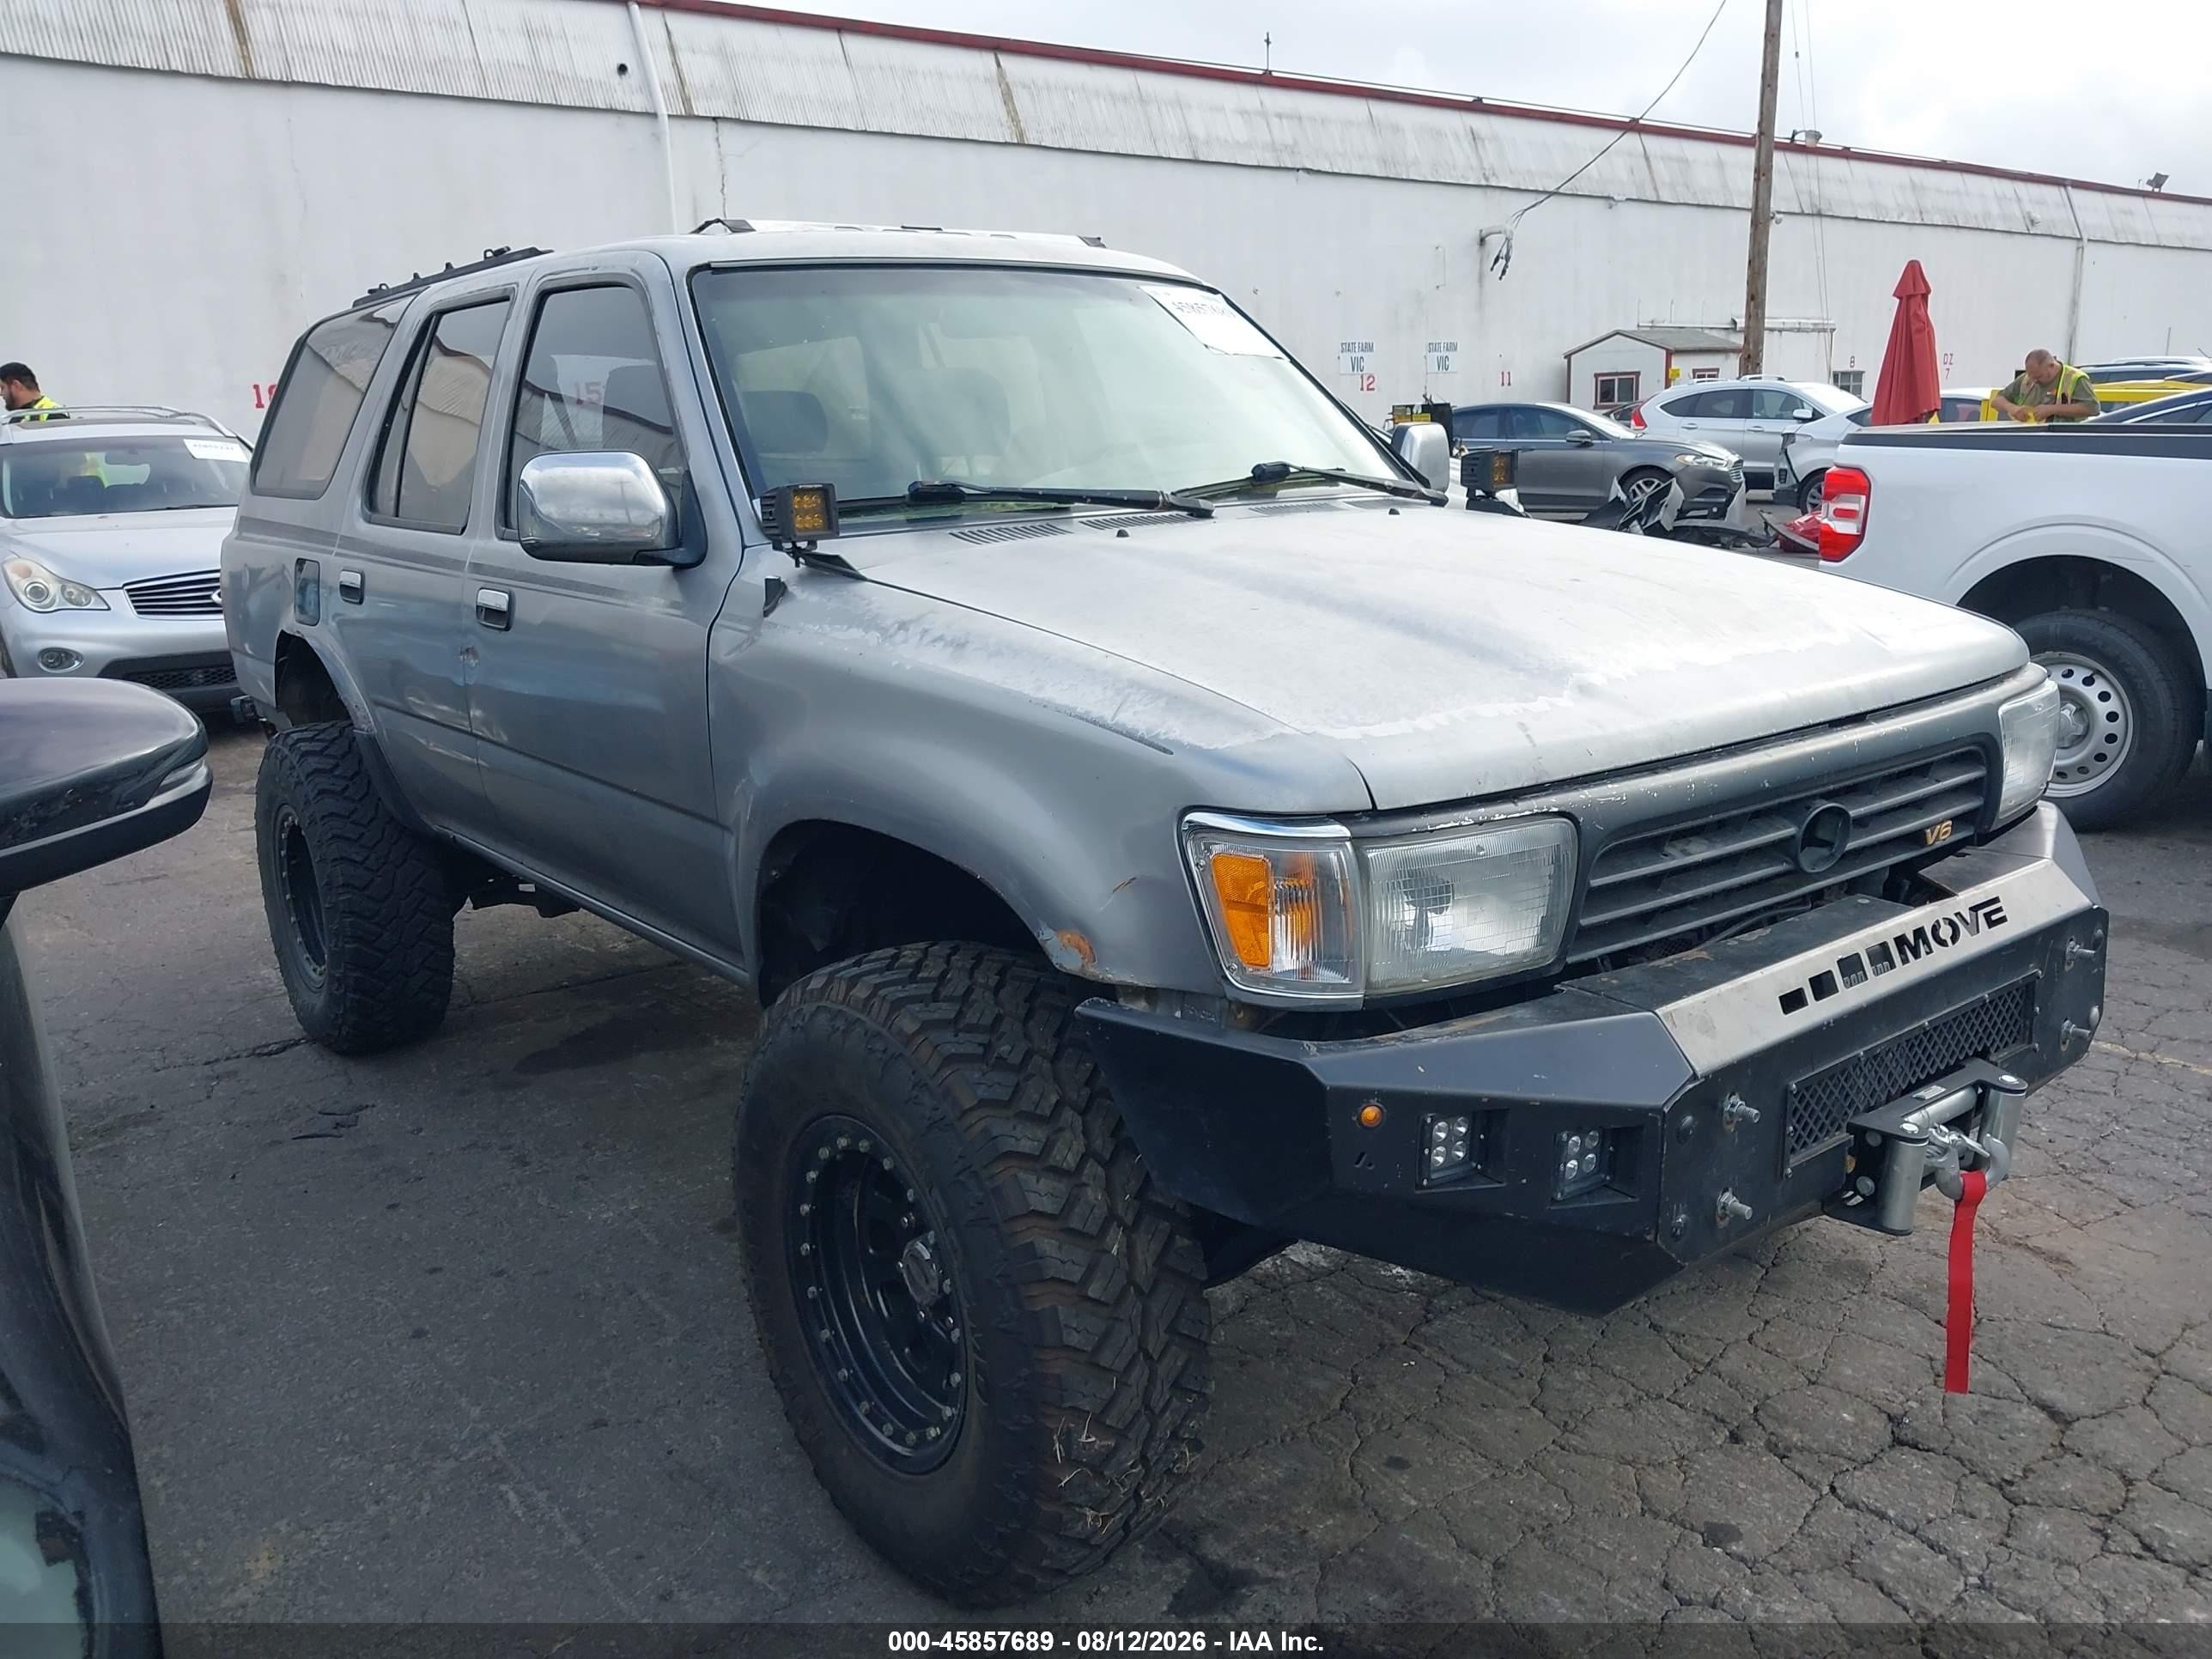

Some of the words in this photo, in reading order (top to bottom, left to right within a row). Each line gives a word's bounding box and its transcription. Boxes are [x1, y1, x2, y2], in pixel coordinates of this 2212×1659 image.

[1340, 342, 1357, 353] STATE
[1358, 342, 1374, 353] FARM
[1428, 342, 1442, 353] STATE
[1443, 342, 1458, 353] FARM
[1351, 356, 1364, 373] VIC
[1437, 356, 1449, 371] VIC
[1850, 356, 1855, 368] 8
[1501, 371, 1511, 386] 11
[1945, 368, 1951, 379] 7
[1360, 374, 1376, 392] 12
[575, 381, 604, 404] 15
[1925, 820, 1954, 846] V6
[1893, 896, 2008, 966] MOVE
